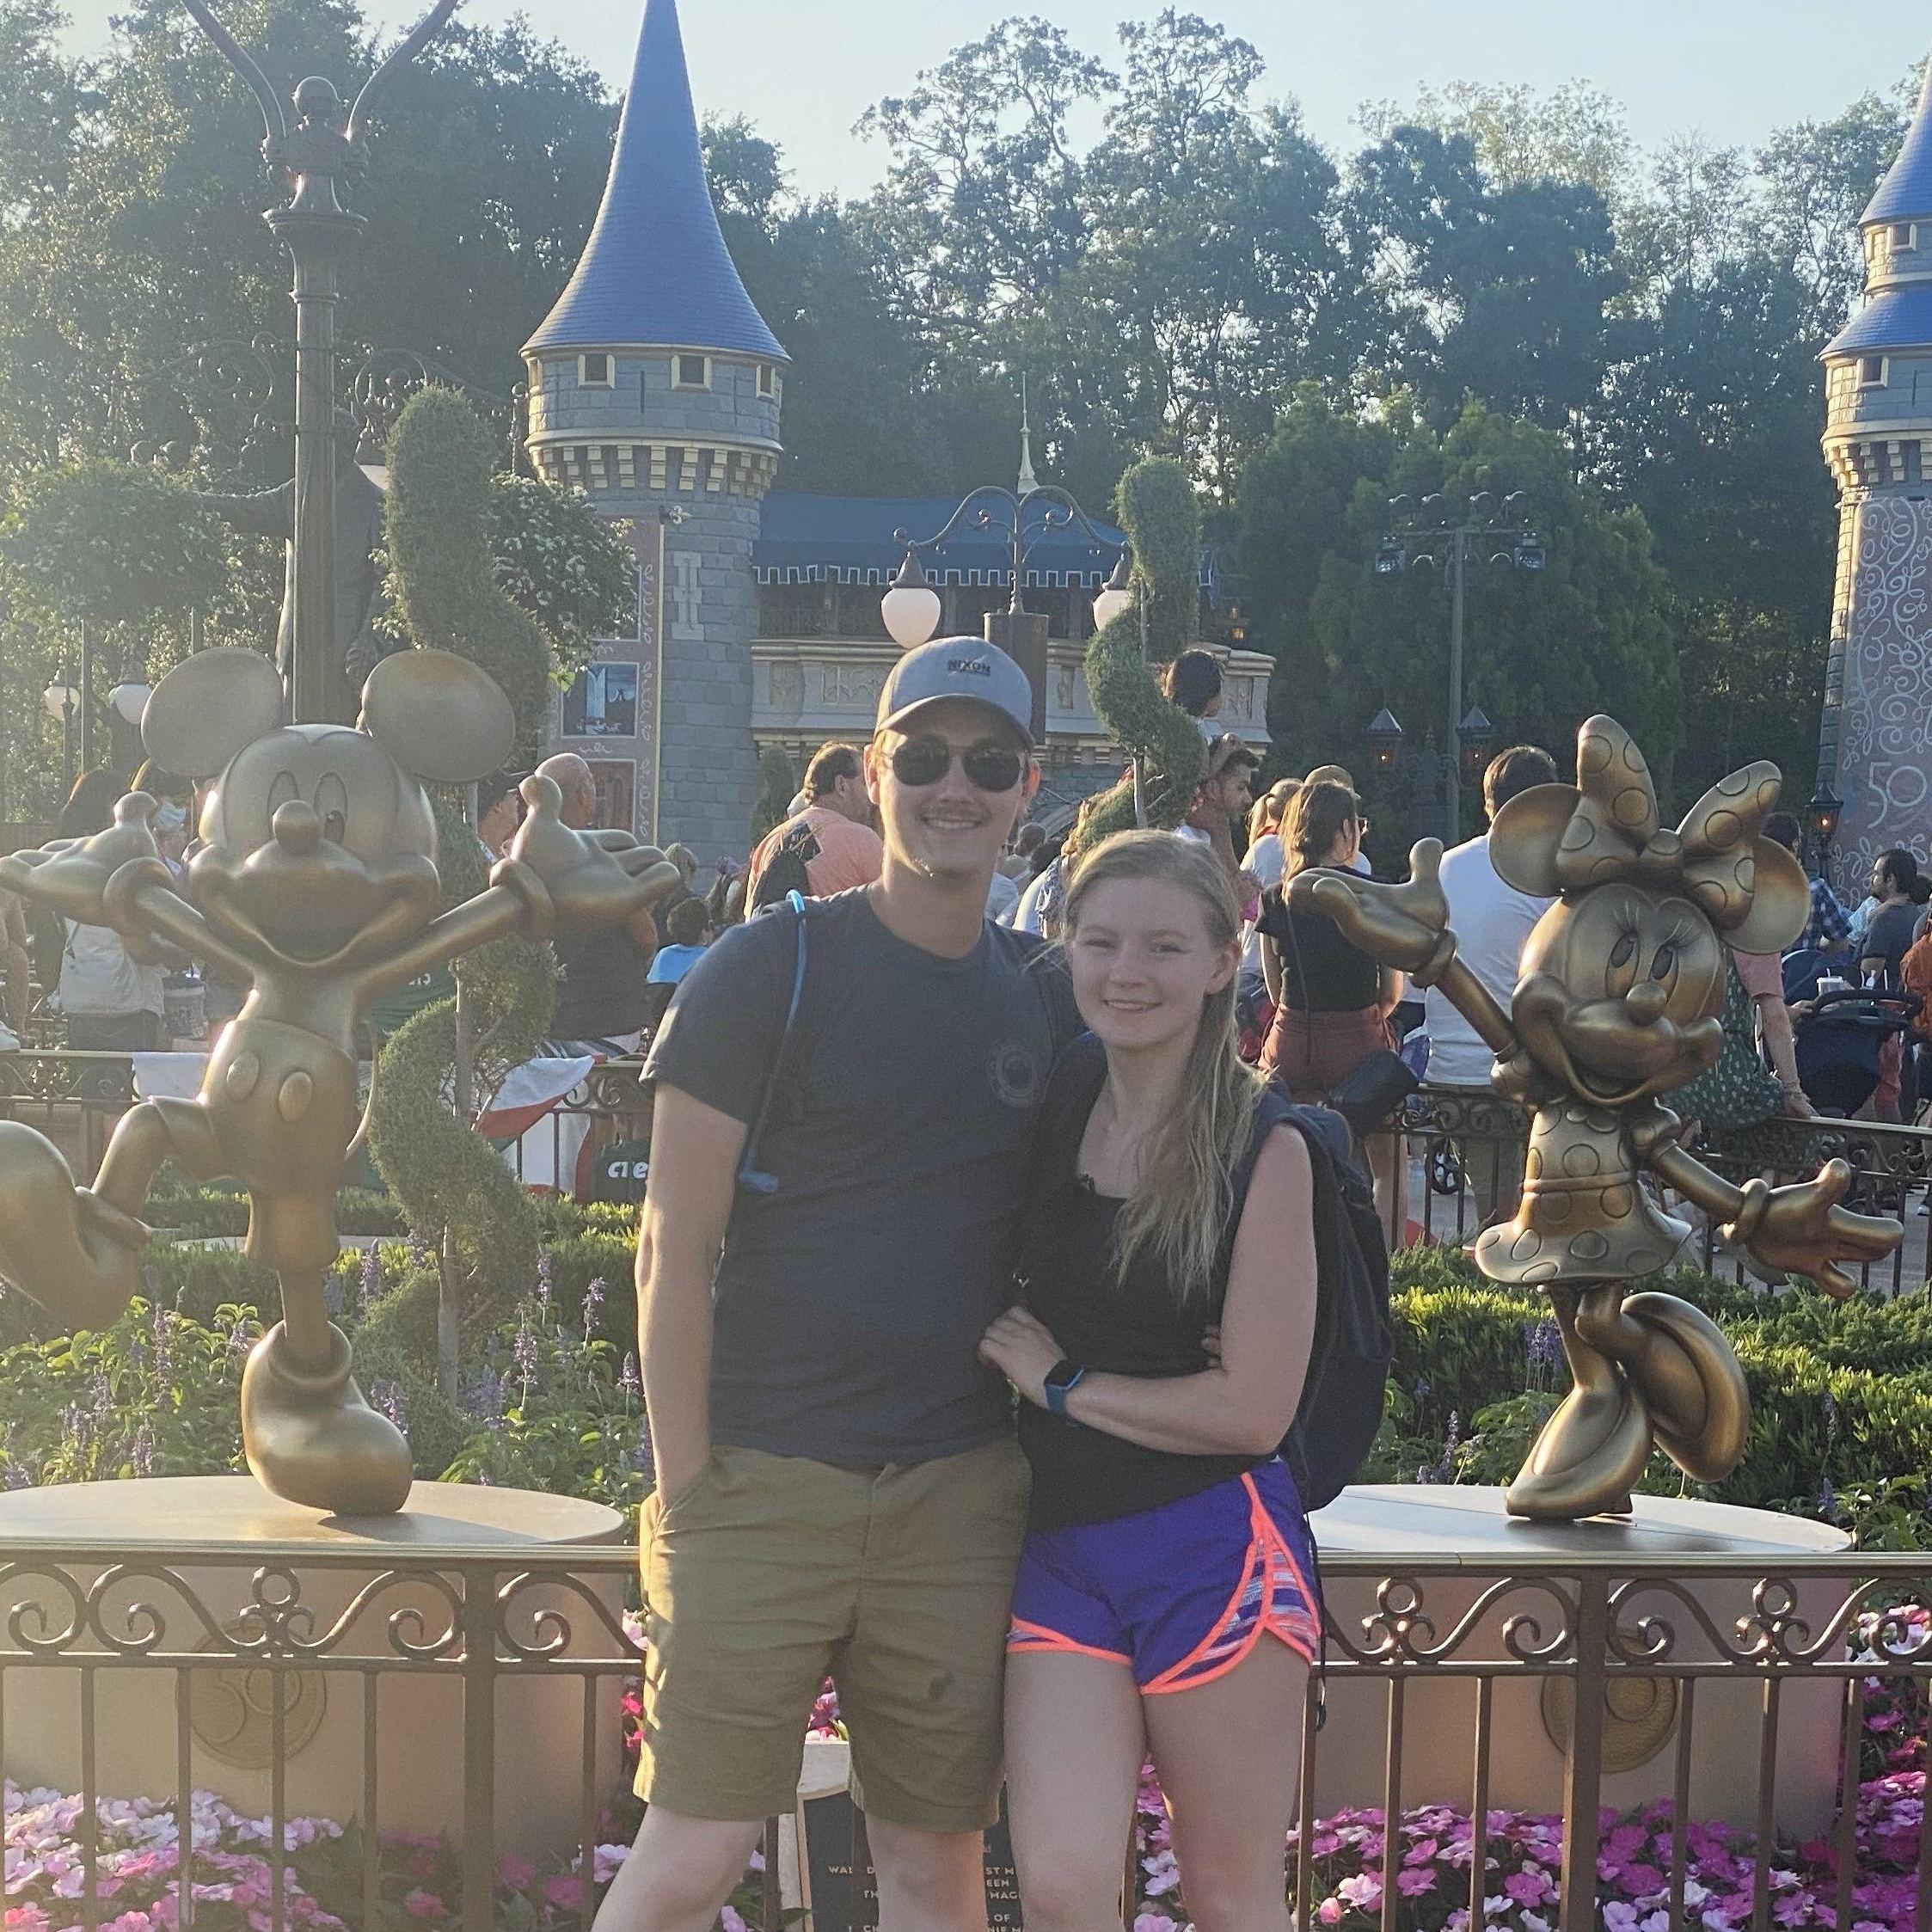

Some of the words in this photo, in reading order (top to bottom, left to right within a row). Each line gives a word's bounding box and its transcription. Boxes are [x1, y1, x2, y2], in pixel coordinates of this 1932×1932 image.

[948, 659, 991, 675] NIXON
[1868, 762, 1927, 828] 50
[994, 1913, 1011, 1923] OF
